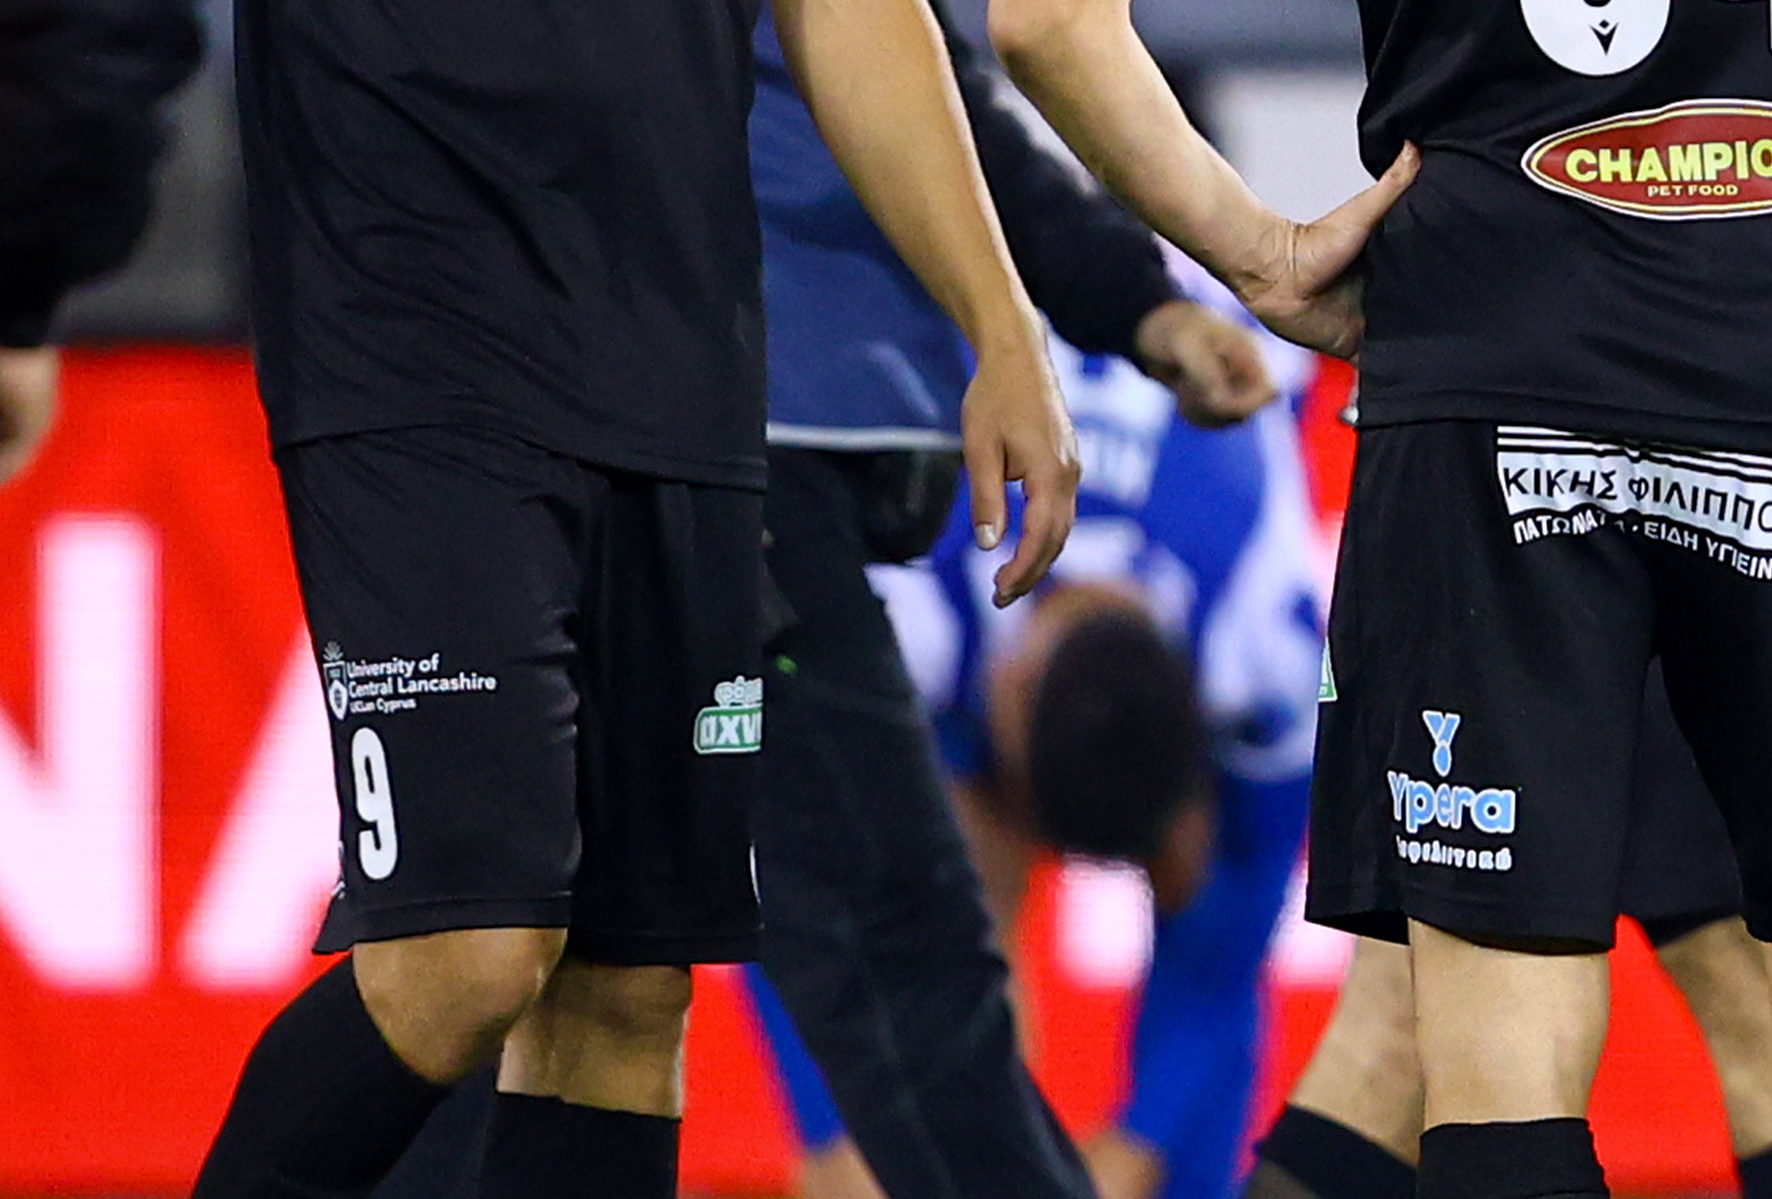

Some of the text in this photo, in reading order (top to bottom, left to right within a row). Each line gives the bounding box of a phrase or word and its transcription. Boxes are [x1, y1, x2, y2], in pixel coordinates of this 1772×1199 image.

[1647, 185, 1739, 197] PET FOOD
[1503, 467, 1617, 500] ΚΙΚΗΣ
[1644, 521, 1698, 551] ΕΙΔΗ
[346, 653, 440, 678] University of
[348, 671, 497, 698] Central Lancashire
[376, 697, 417, 713] Cyprus
[350, 726, 398, 881] 9
[1387, 770, 1516, 834] Ypera
